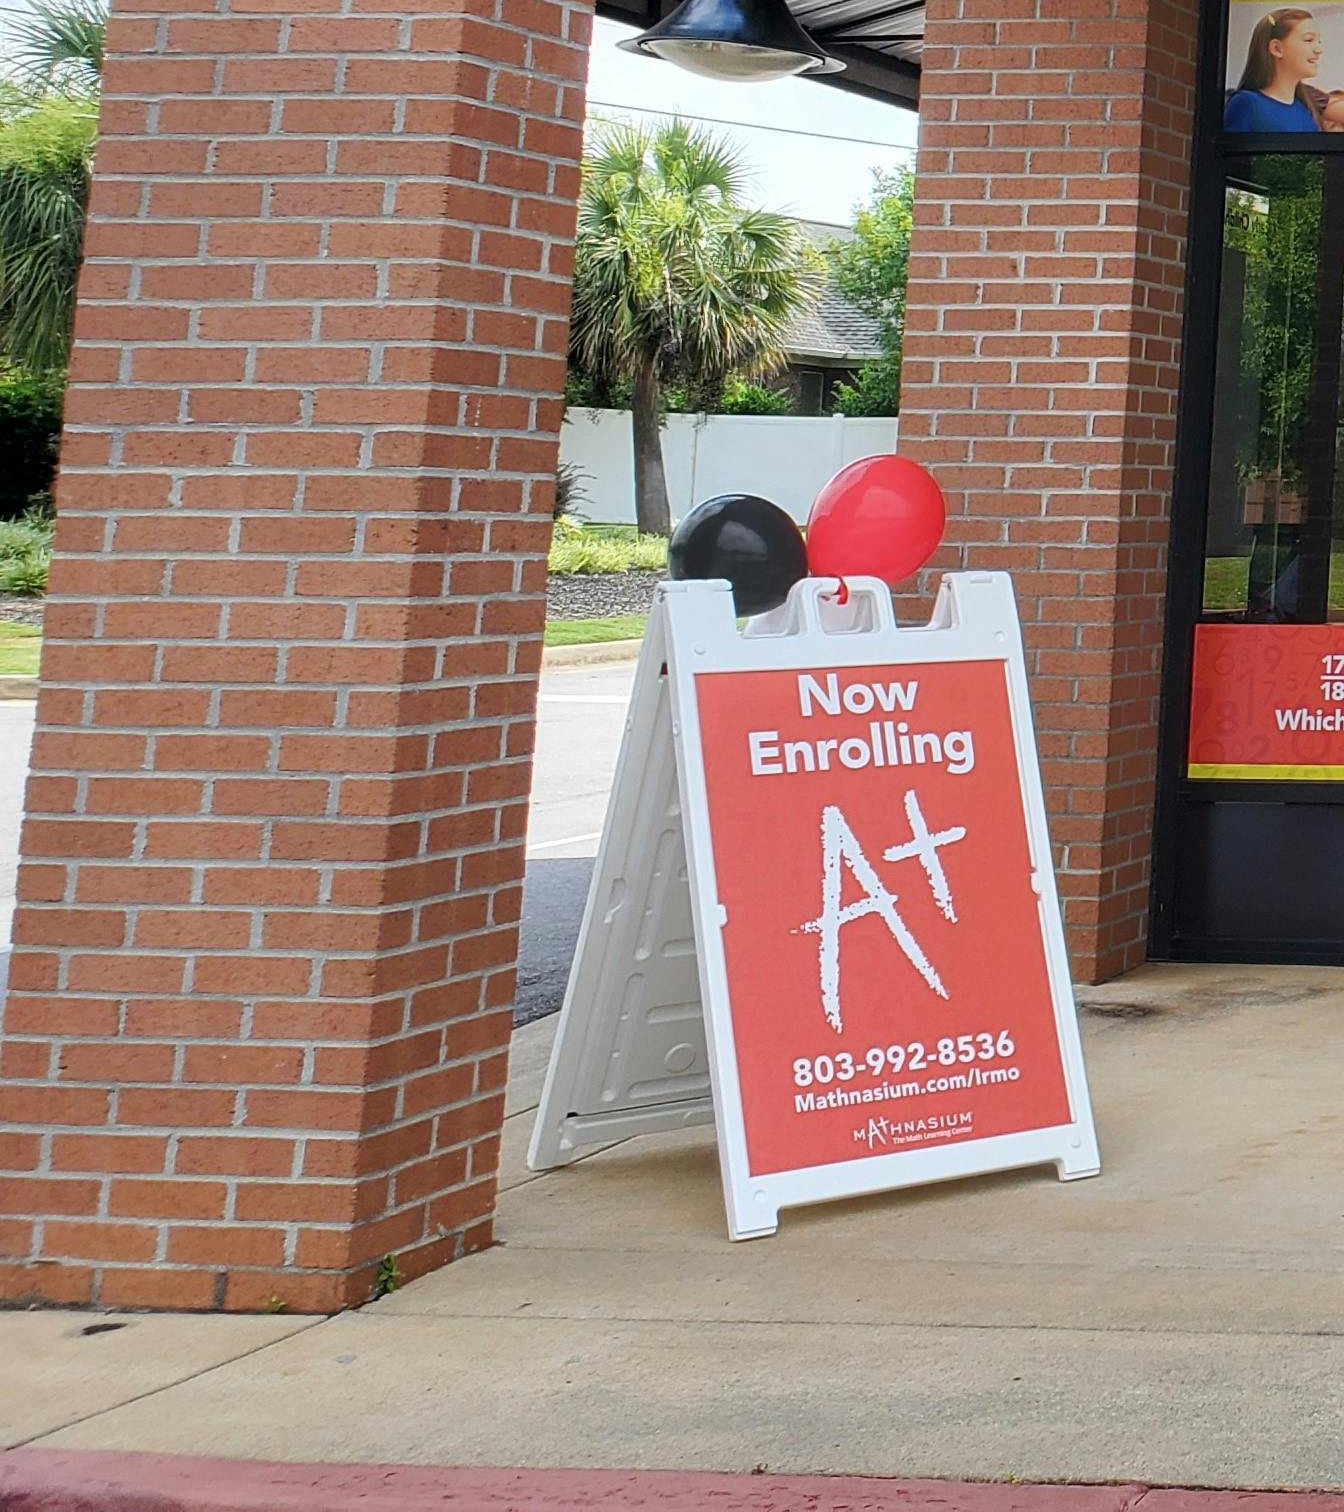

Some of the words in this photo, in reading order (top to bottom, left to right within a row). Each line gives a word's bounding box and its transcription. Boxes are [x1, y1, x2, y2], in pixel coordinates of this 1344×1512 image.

[798, 673, 919, 717] Now
[747, 720, 976, 776] Enrolling
[792, 1030, 1016, 1087] 803-992-8536
[793, 1066, 1021, 1114] Mathnasium.com/Irmo
